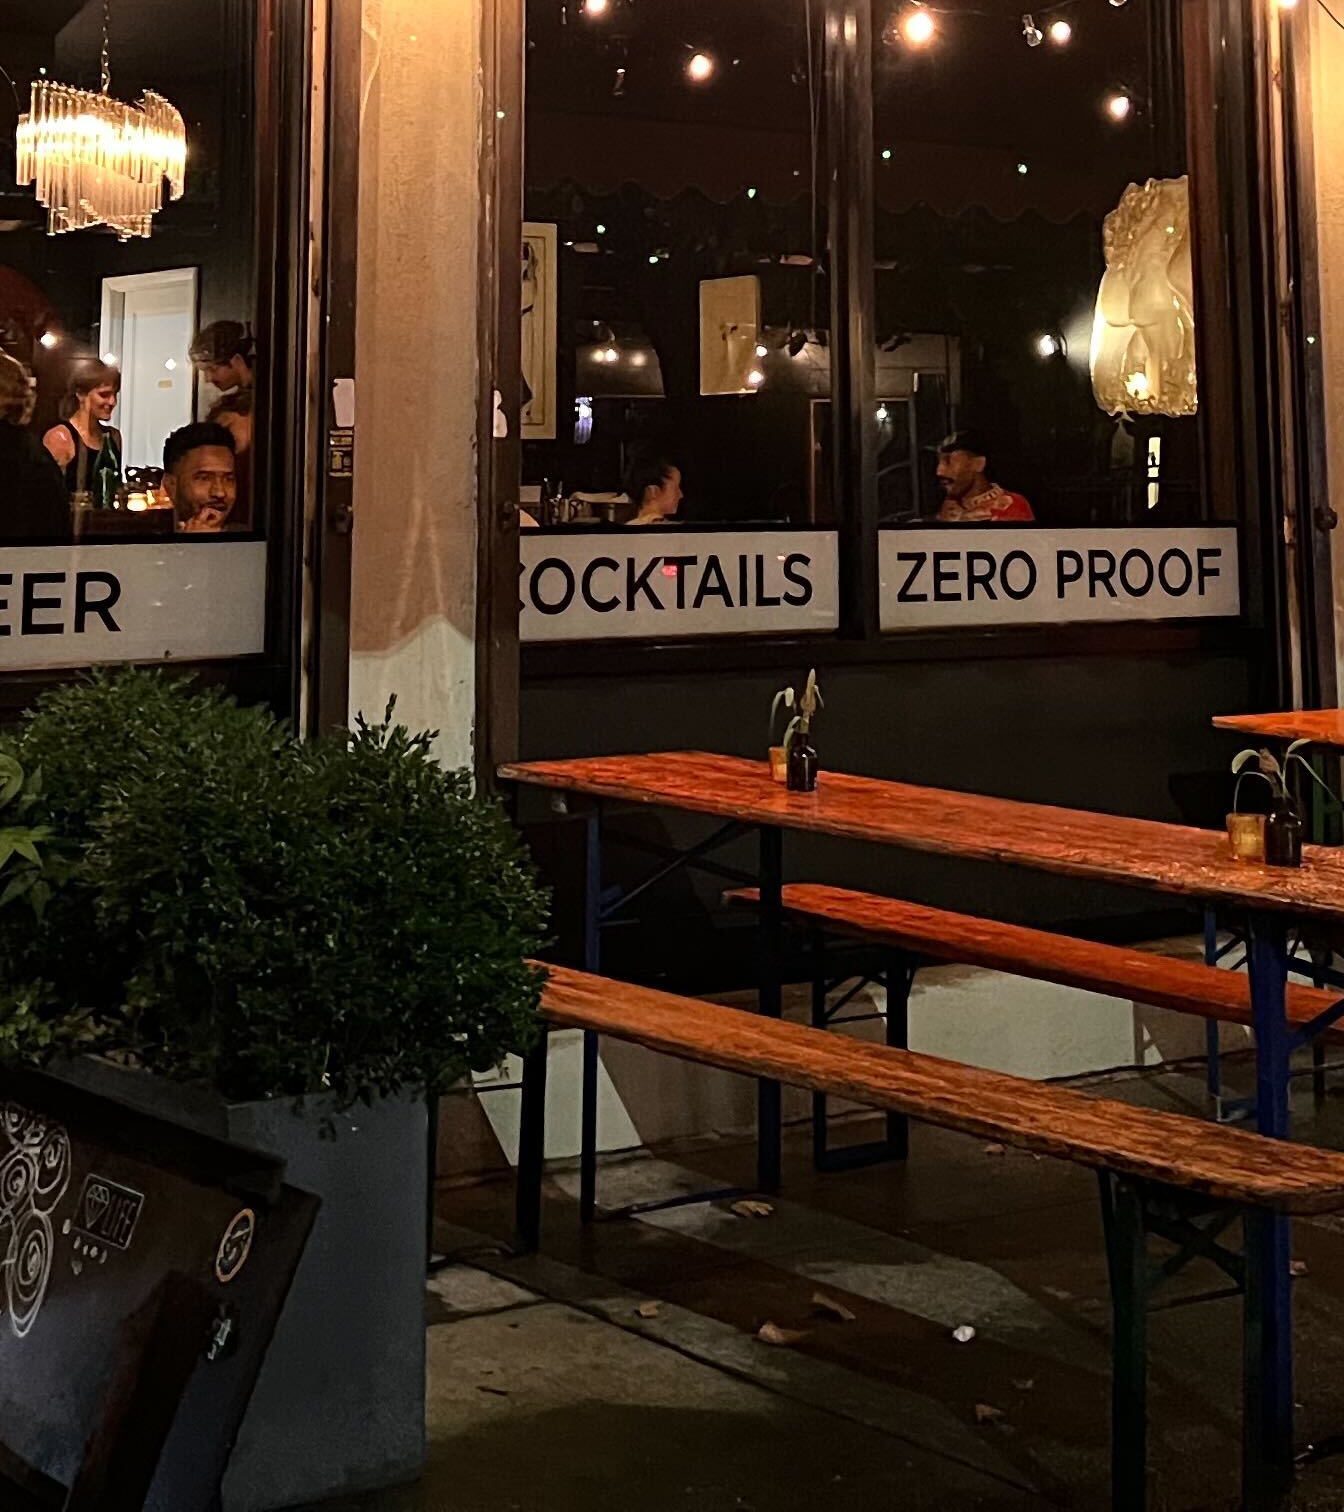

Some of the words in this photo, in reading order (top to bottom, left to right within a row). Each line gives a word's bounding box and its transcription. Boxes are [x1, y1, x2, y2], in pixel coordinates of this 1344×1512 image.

[519, 553, 812, 615] OCKTAILS
[897, 550, 1037, 602] ZERO
[1057, 548, 1222, 598] PROOF
